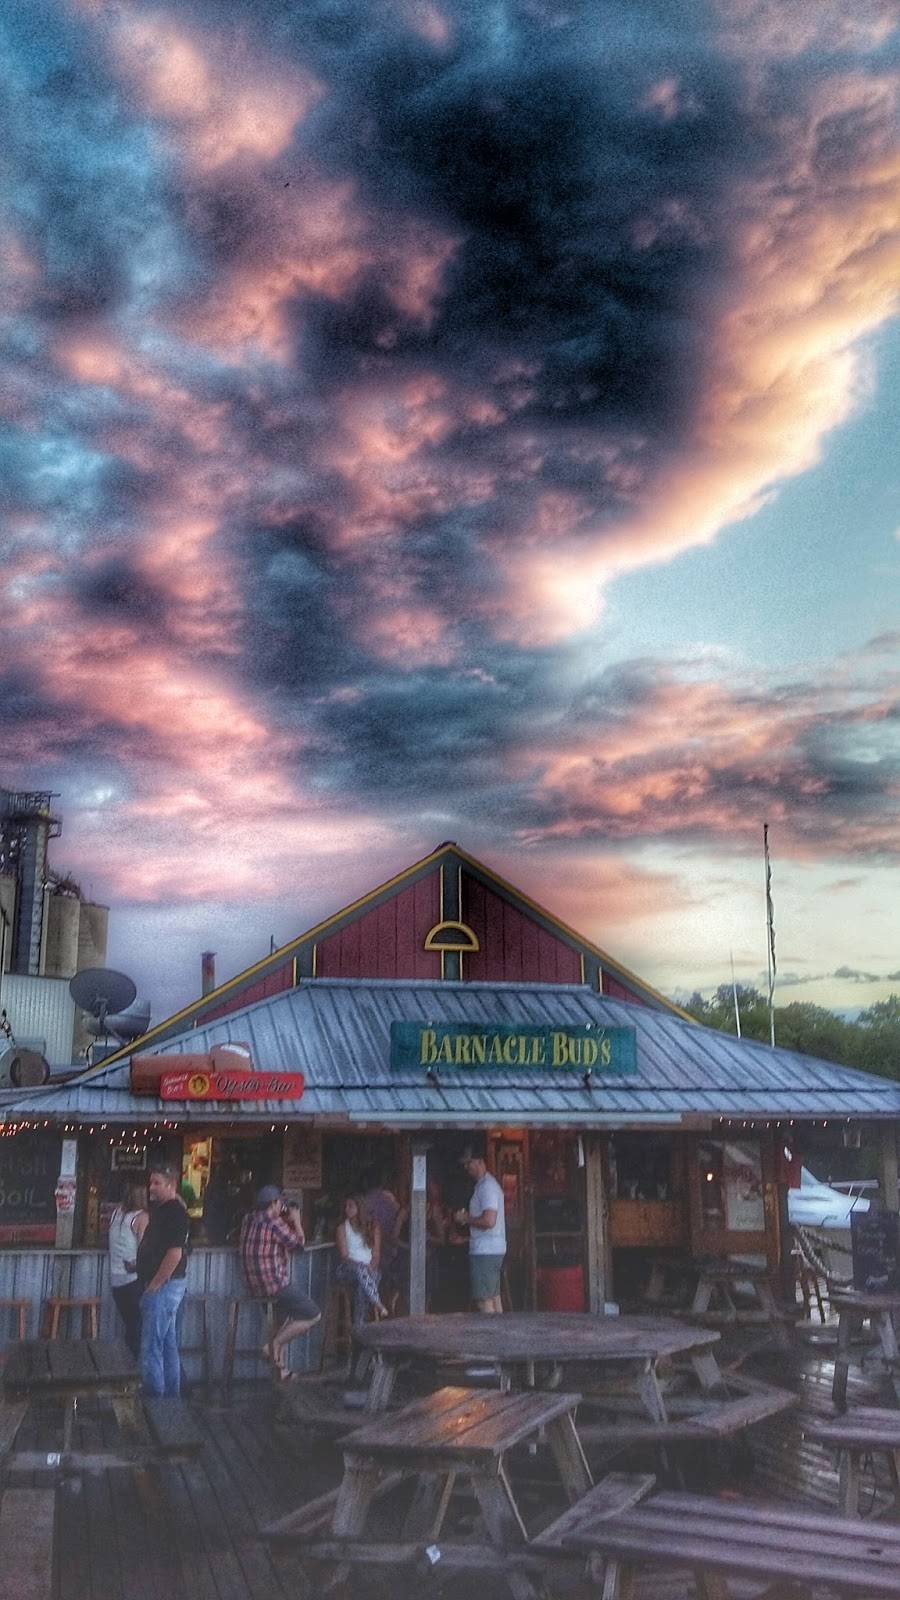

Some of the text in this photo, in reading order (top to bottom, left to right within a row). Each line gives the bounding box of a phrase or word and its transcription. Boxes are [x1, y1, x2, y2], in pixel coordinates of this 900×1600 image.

[420, 1029, 611, 1067] BARNACLE BUD'S
[216, 1076, 295, 1098] Oyster Bar
